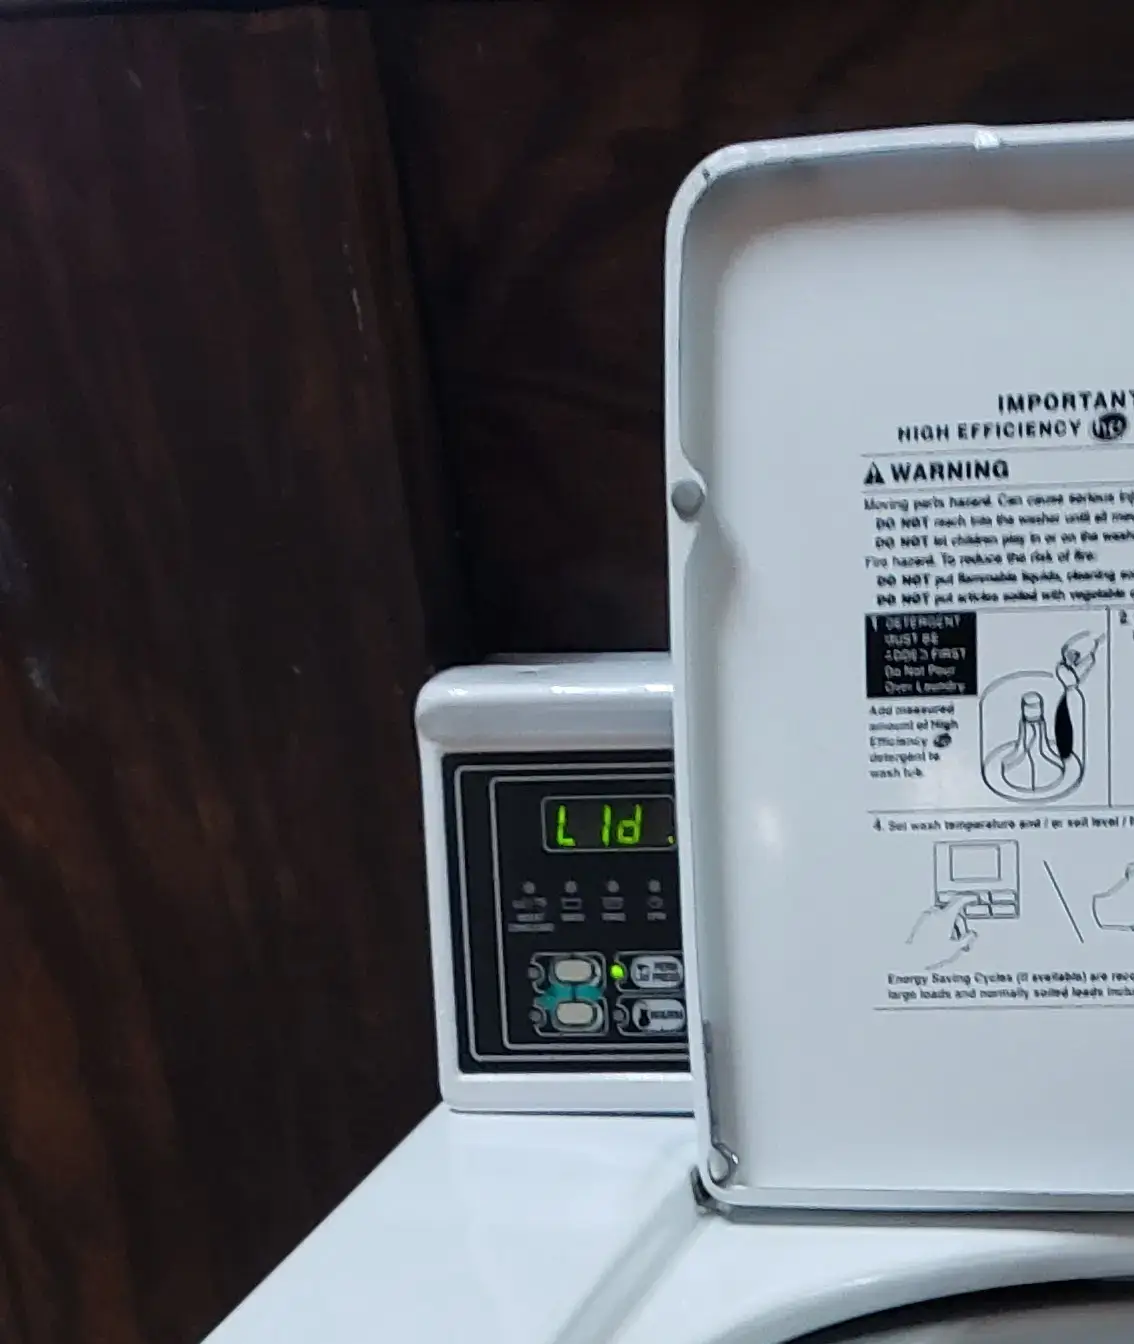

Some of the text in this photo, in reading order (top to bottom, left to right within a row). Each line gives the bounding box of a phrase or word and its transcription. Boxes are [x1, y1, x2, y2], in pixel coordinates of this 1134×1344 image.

[896, 425, 951, 442] HIGH
[956, 420, 1082, 439] EFFICIENCY
[889, 460, 1010, 481] WARNING
[900, 516, 929, 528] NOT
[900, 535, 929, 547] NOT
[901, 574, 931, 585] NOT
[901, 592, 930, 605] NOT
